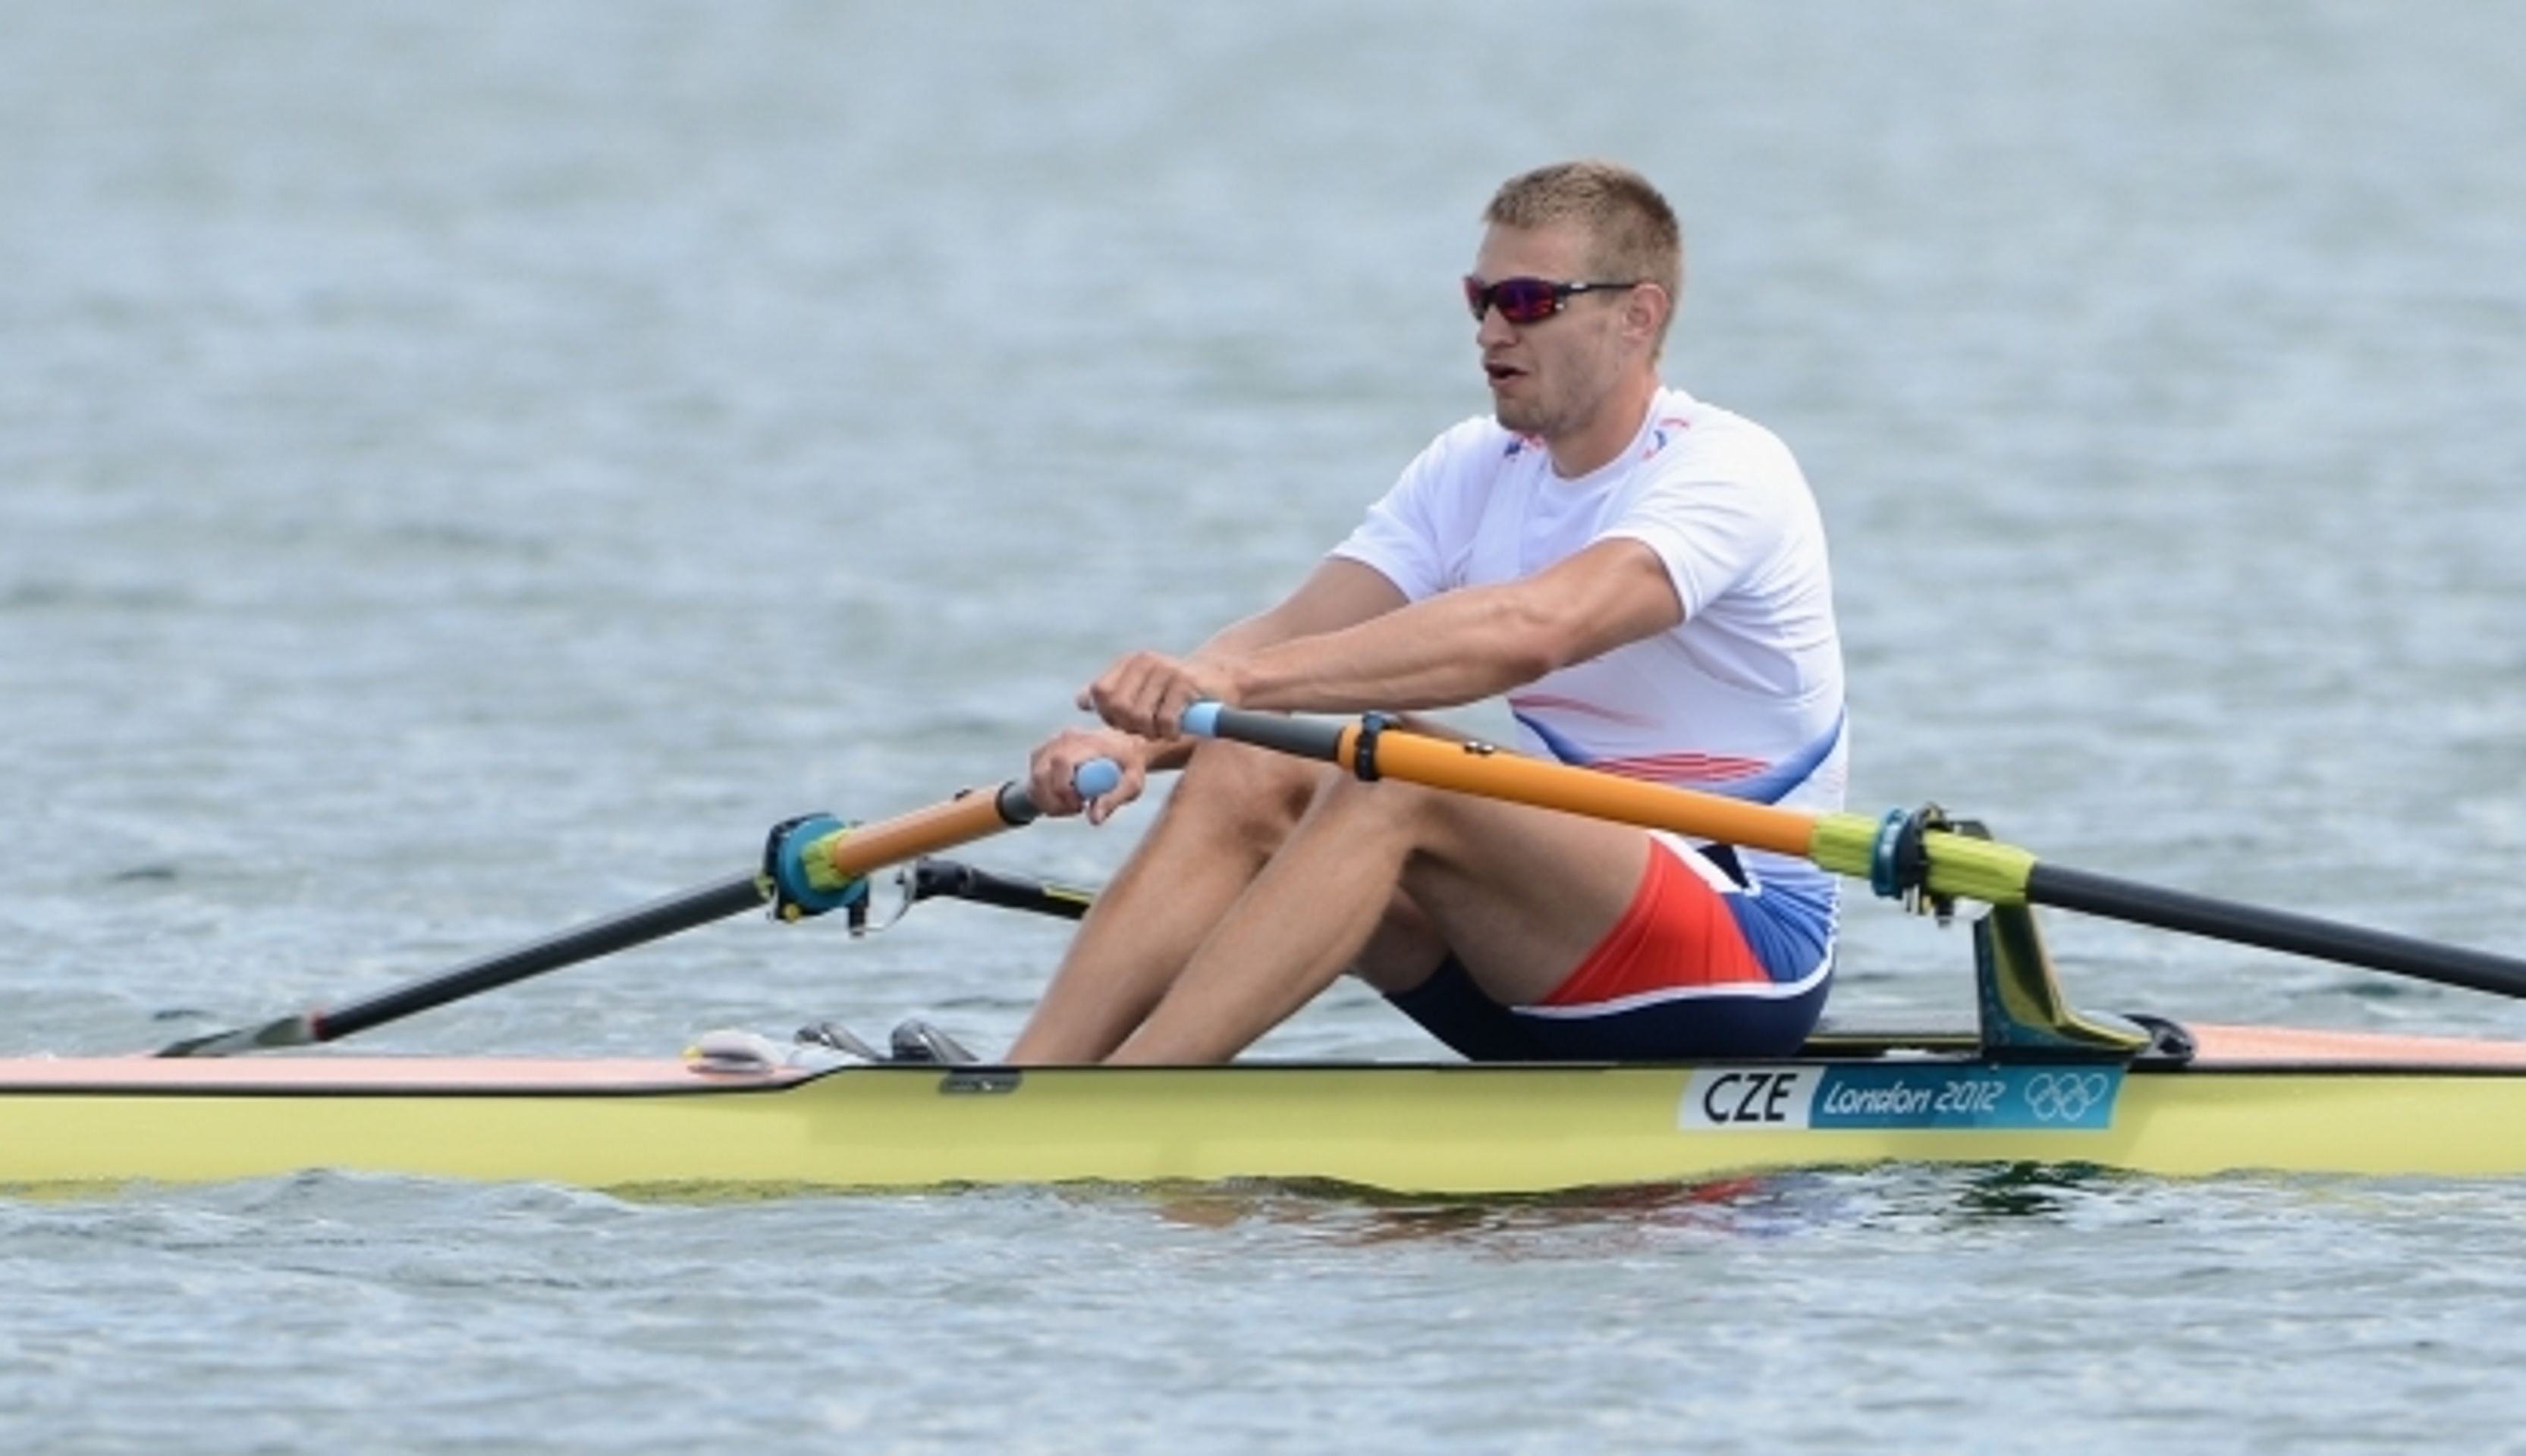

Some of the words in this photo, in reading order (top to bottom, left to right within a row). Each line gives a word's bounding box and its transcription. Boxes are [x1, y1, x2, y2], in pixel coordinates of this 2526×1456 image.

[1703, 1073, 1799, 1123] CZE
[1823, 1080, 1933, 1114] London
[1934, 1081, 2007, 1112] 2012
